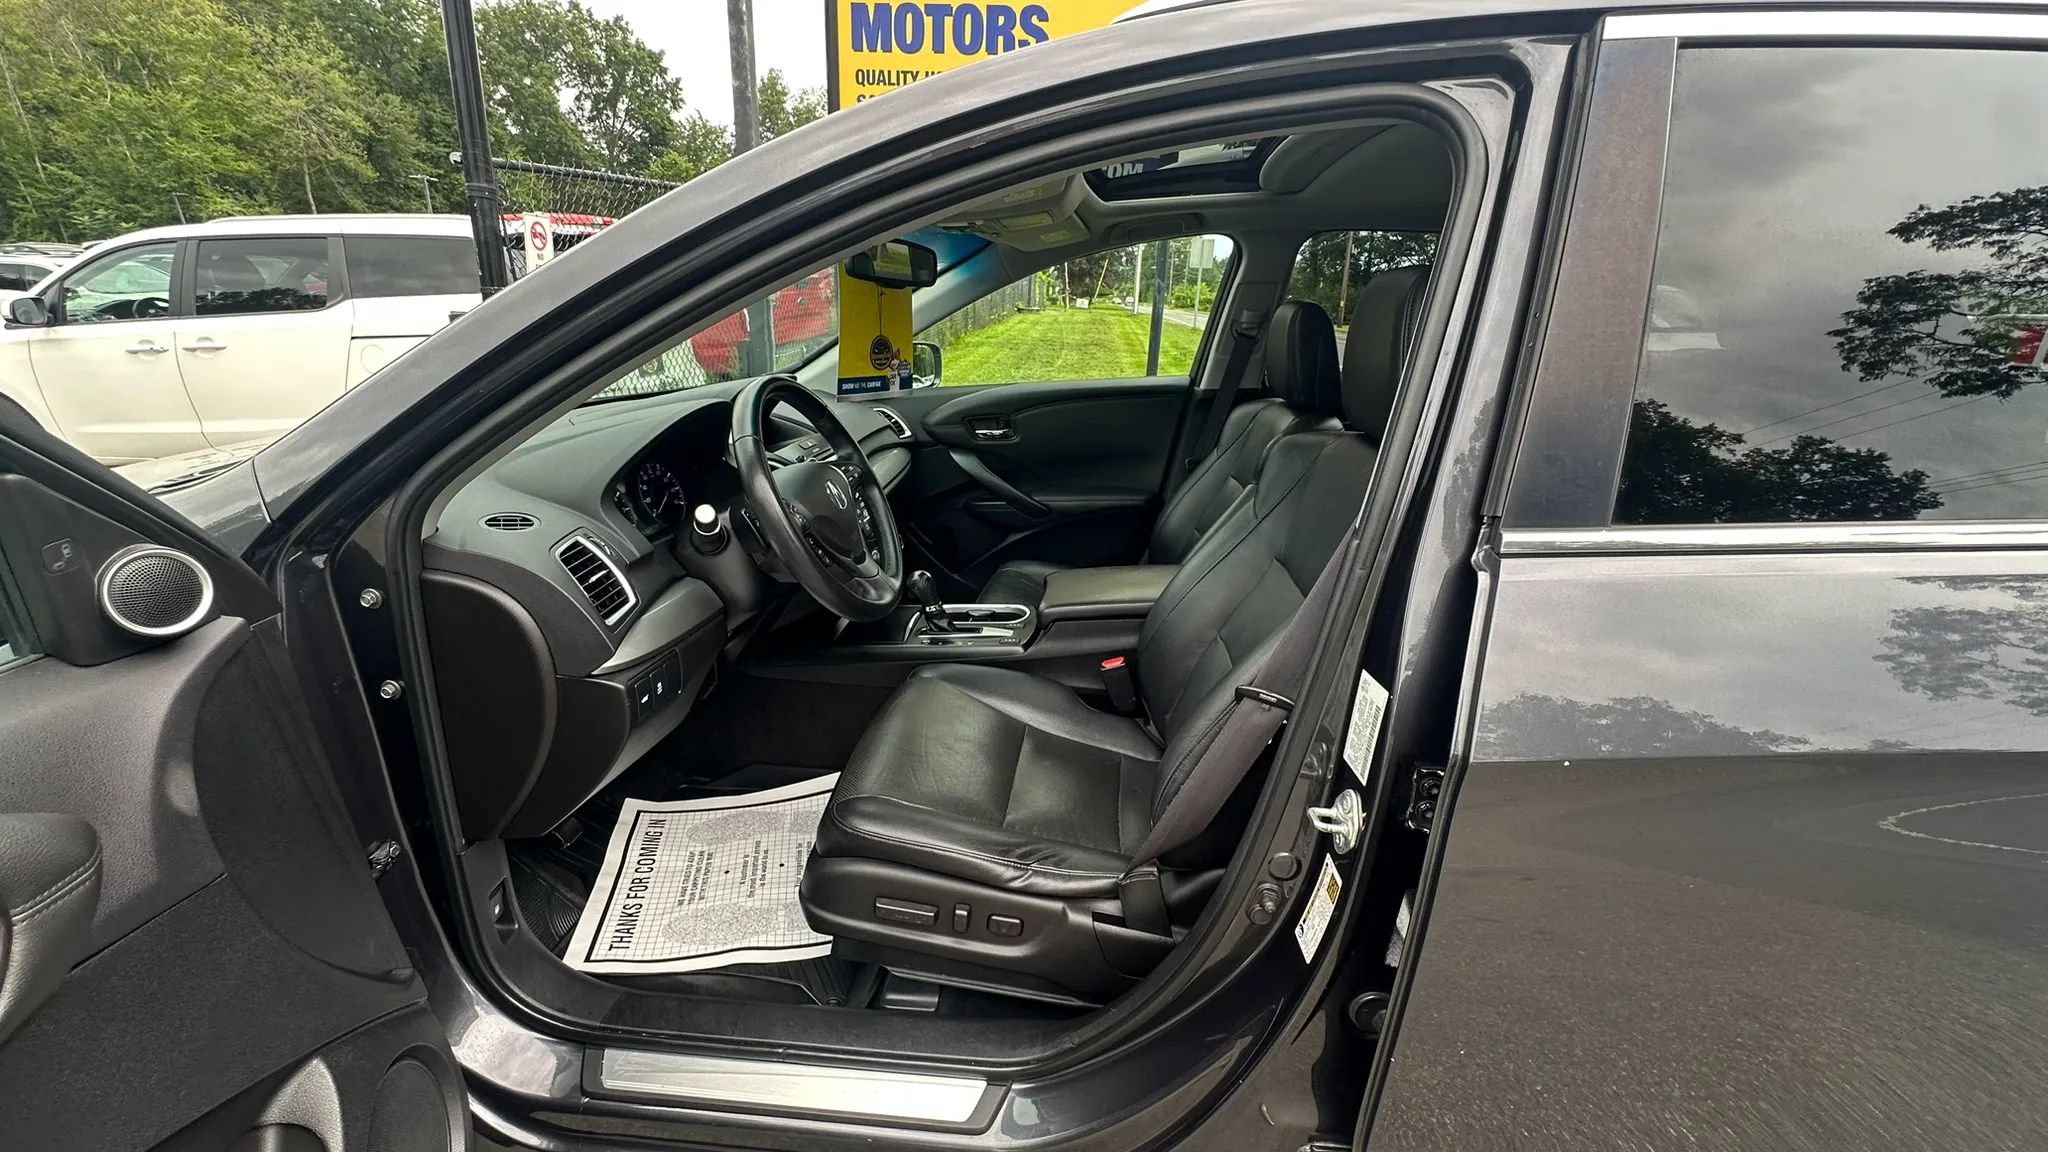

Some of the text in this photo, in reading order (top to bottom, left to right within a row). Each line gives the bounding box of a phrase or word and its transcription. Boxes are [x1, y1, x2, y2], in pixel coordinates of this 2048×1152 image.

[850, 2, 1050, 55] MOTORS
[855, 68, 919, 87] QUALITY
[1102, 163, 1144, 179] OM
[682, 870, 692, 885] TRIED
[688, 851, 696, 863] KEEP
[696, 851, 705, 865] CLEAN
[608, 819, 667, 951] THANKS FOR COMING IN
